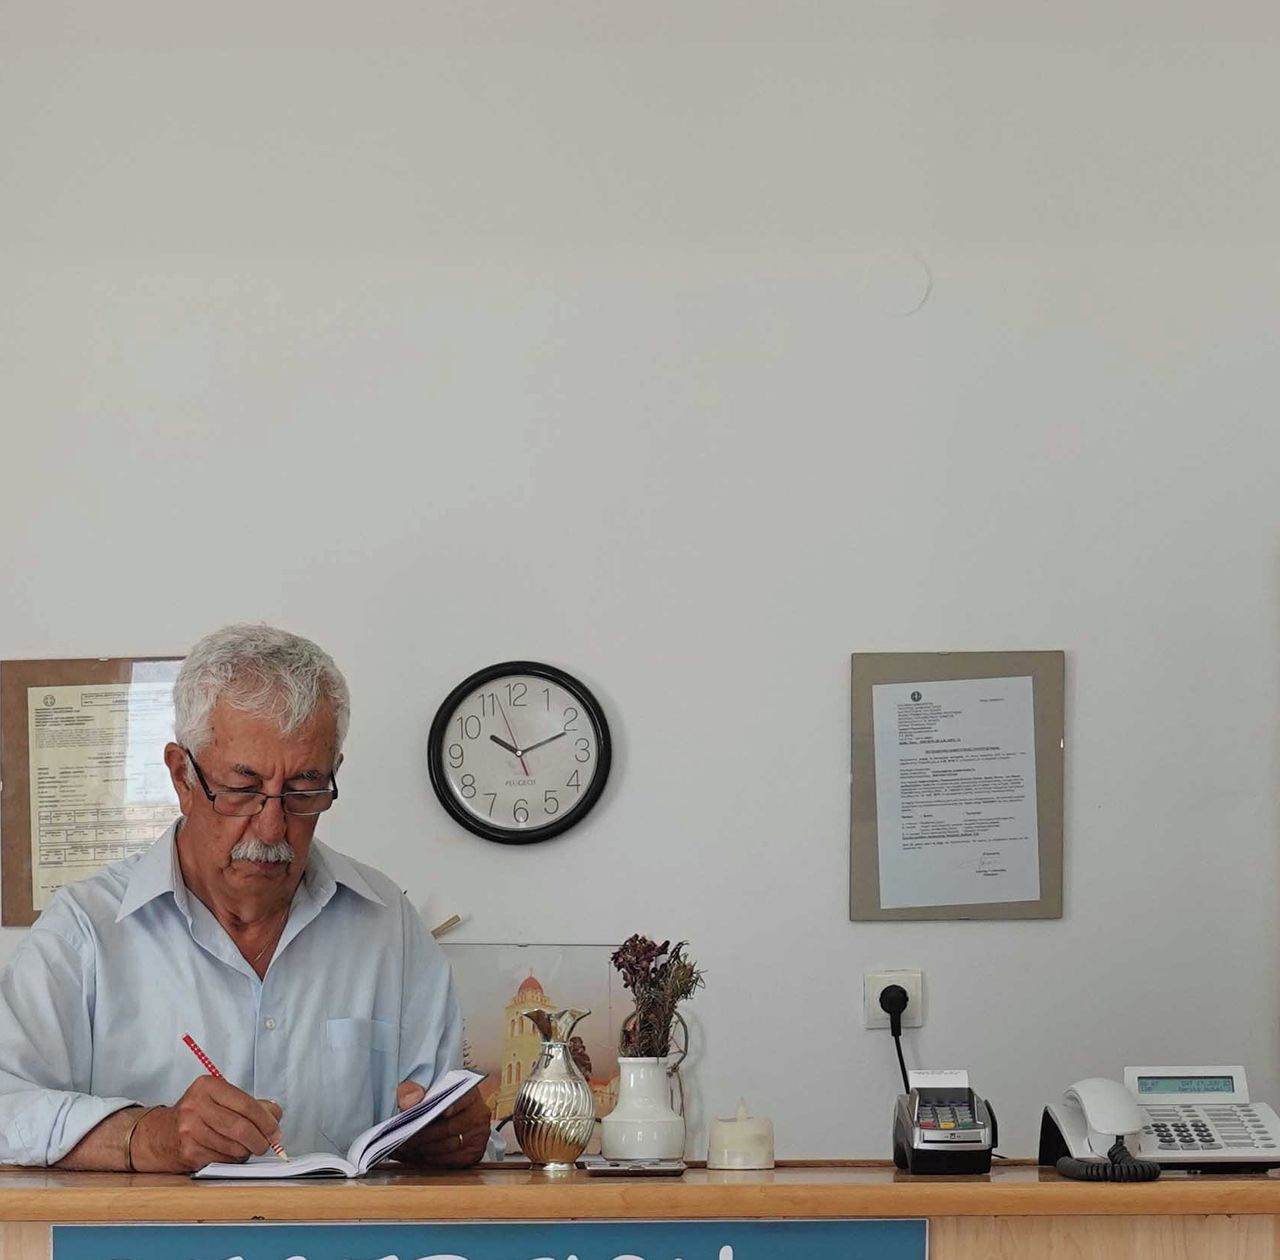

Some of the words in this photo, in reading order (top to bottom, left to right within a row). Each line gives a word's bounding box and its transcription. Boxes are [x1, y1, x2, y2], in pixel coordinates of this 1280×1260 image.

[478, 693, 495, 716] 11
[505, 682, 527, 707] 12
[543, 688, 549, 711] 1
[457, 715, 481, 740] 10
[564, 708, 578, 731] 2
[449, 744, 464, 768] 9
[575, 738, 590, 762] 3
[461, 774, 476, 798] 8
[566, 770, 580, 792] 4
[484, 793, 497, 816] 7
[514, 799, 529, 823] 6
[544, 790, 559, 814] 5
